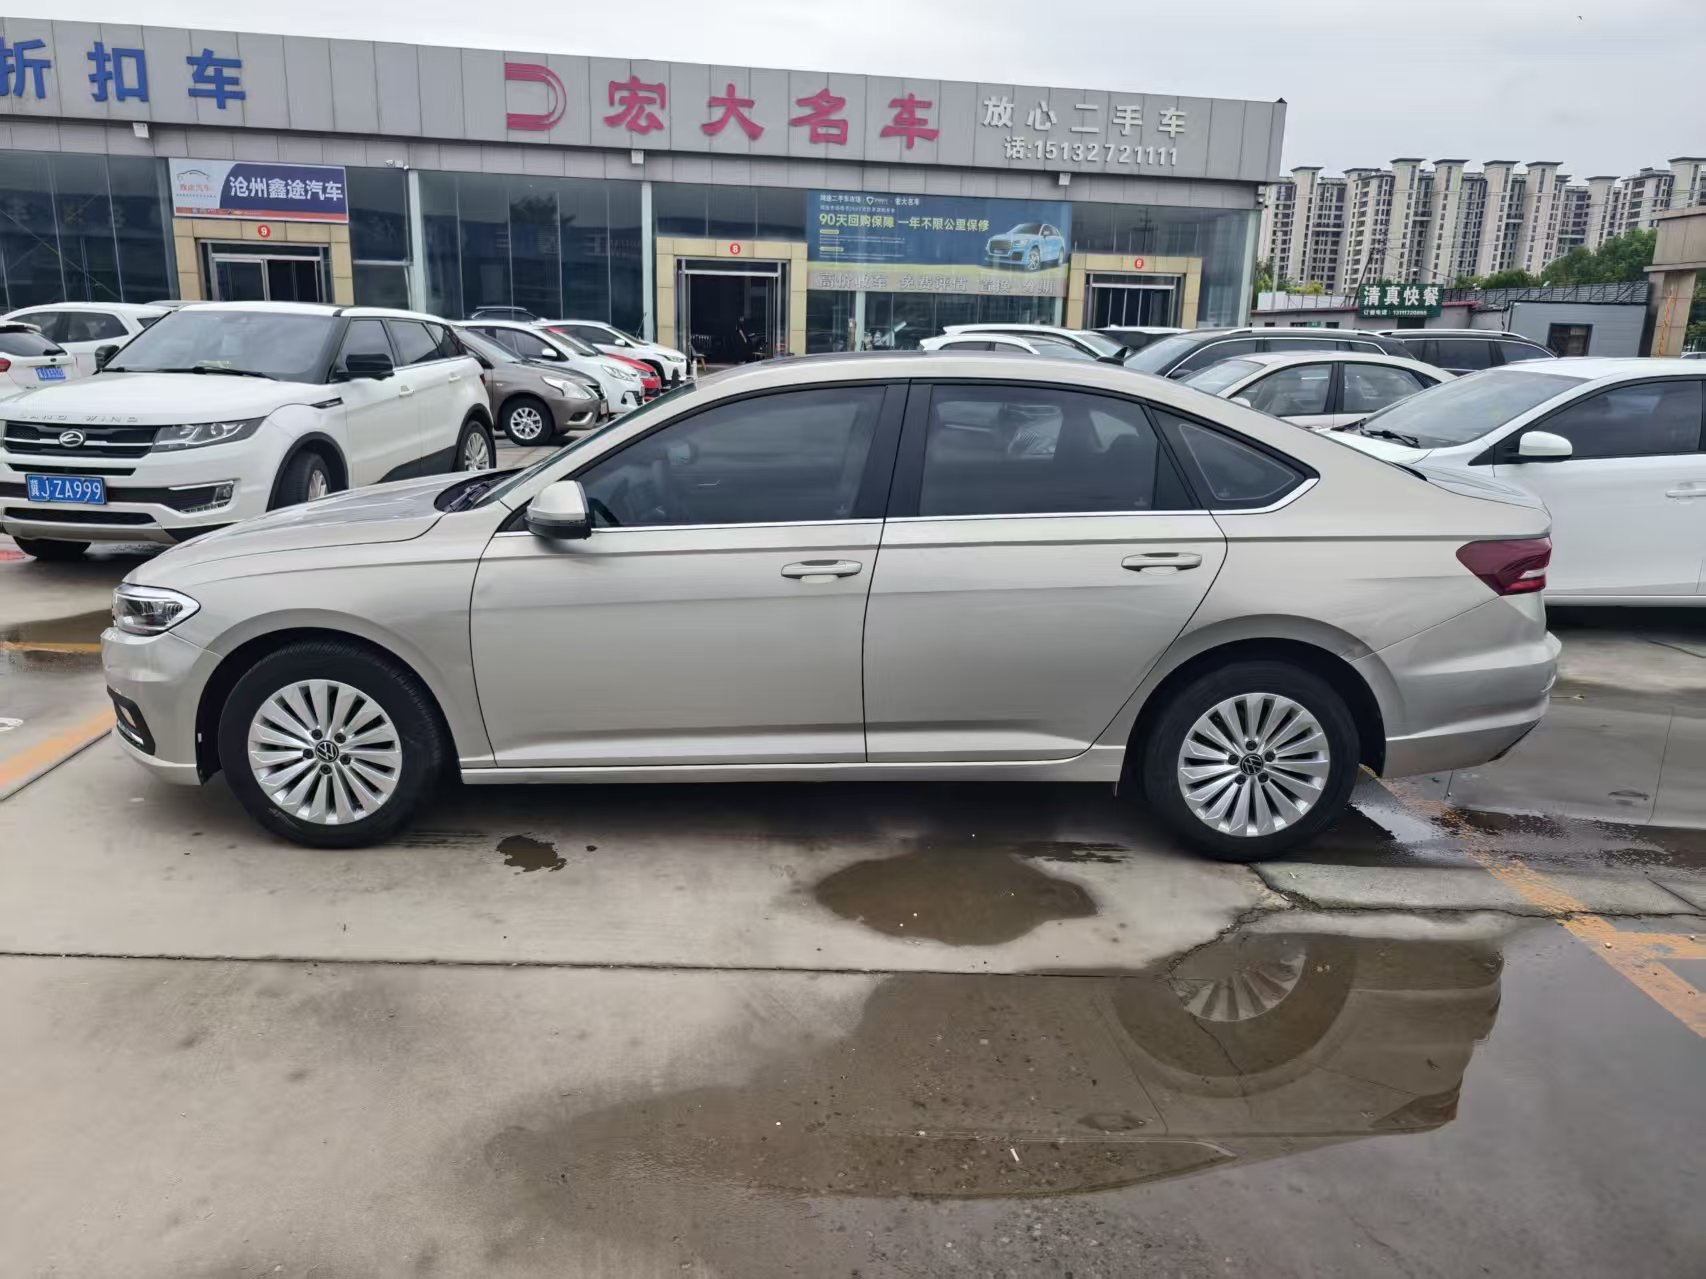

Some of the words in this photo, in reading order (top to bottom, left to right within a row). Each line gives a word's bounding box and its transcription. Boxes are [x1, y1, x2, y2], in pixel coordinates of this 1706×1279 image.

[0, 36, 246, 109] 折扣车
[602, 75, 940, 150] 宏大名车
[982, 95, 1187, 138] 放心二手车
[229, 176, 344, 201] 沧州鑫途汽车
[819, 213, 895, 228] 90天回购保障
[898, 217, 990, 232] 一年不限公里保修
[1363, 285, 1439, 306] 清真快餐
